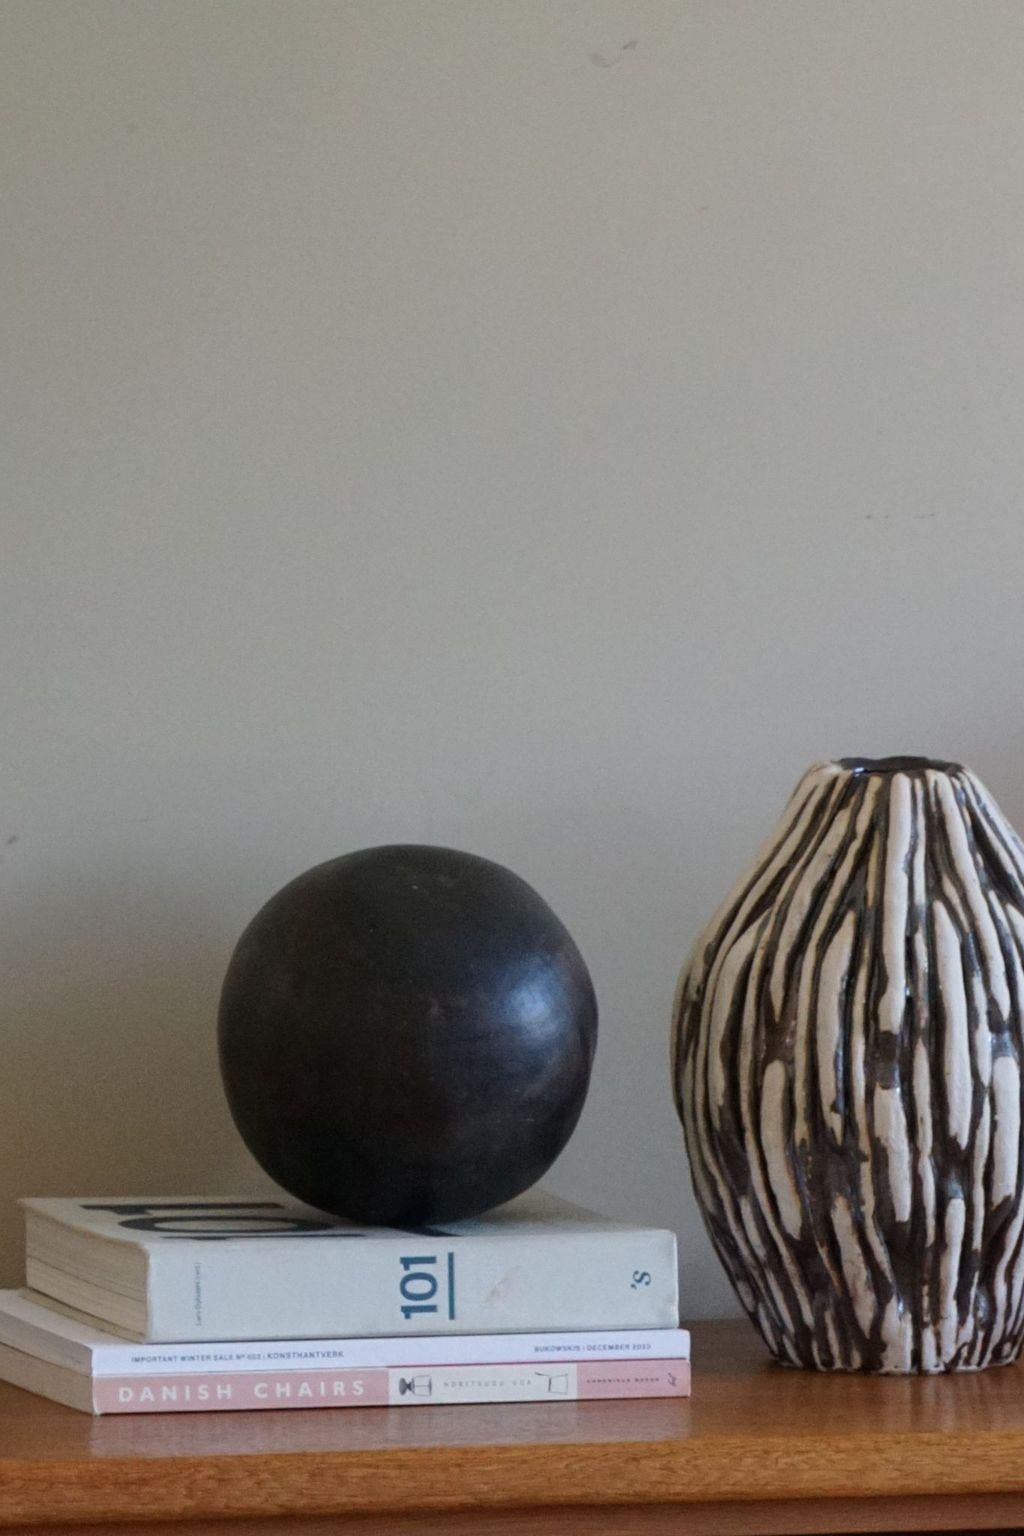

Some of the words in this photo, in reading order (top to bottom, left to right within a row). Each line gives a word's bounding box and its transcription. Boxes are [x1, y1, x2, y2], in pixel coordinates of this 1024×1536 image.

[400, 1256, 438, 1320] 101
[586, 1343, 630, 1352] DECEMBER
[131, 1354, 178, 1363] IMPORTANT
[180, 1354, 211, 1362] WINTER
[213, 1353, 233, 1361] SALE
[267, 1350, 345, 1360] KONSTHANTVERK
[118, 1384, 233, 1403] DANISH
[253, 1380, 366, 1399] CHAIRS
